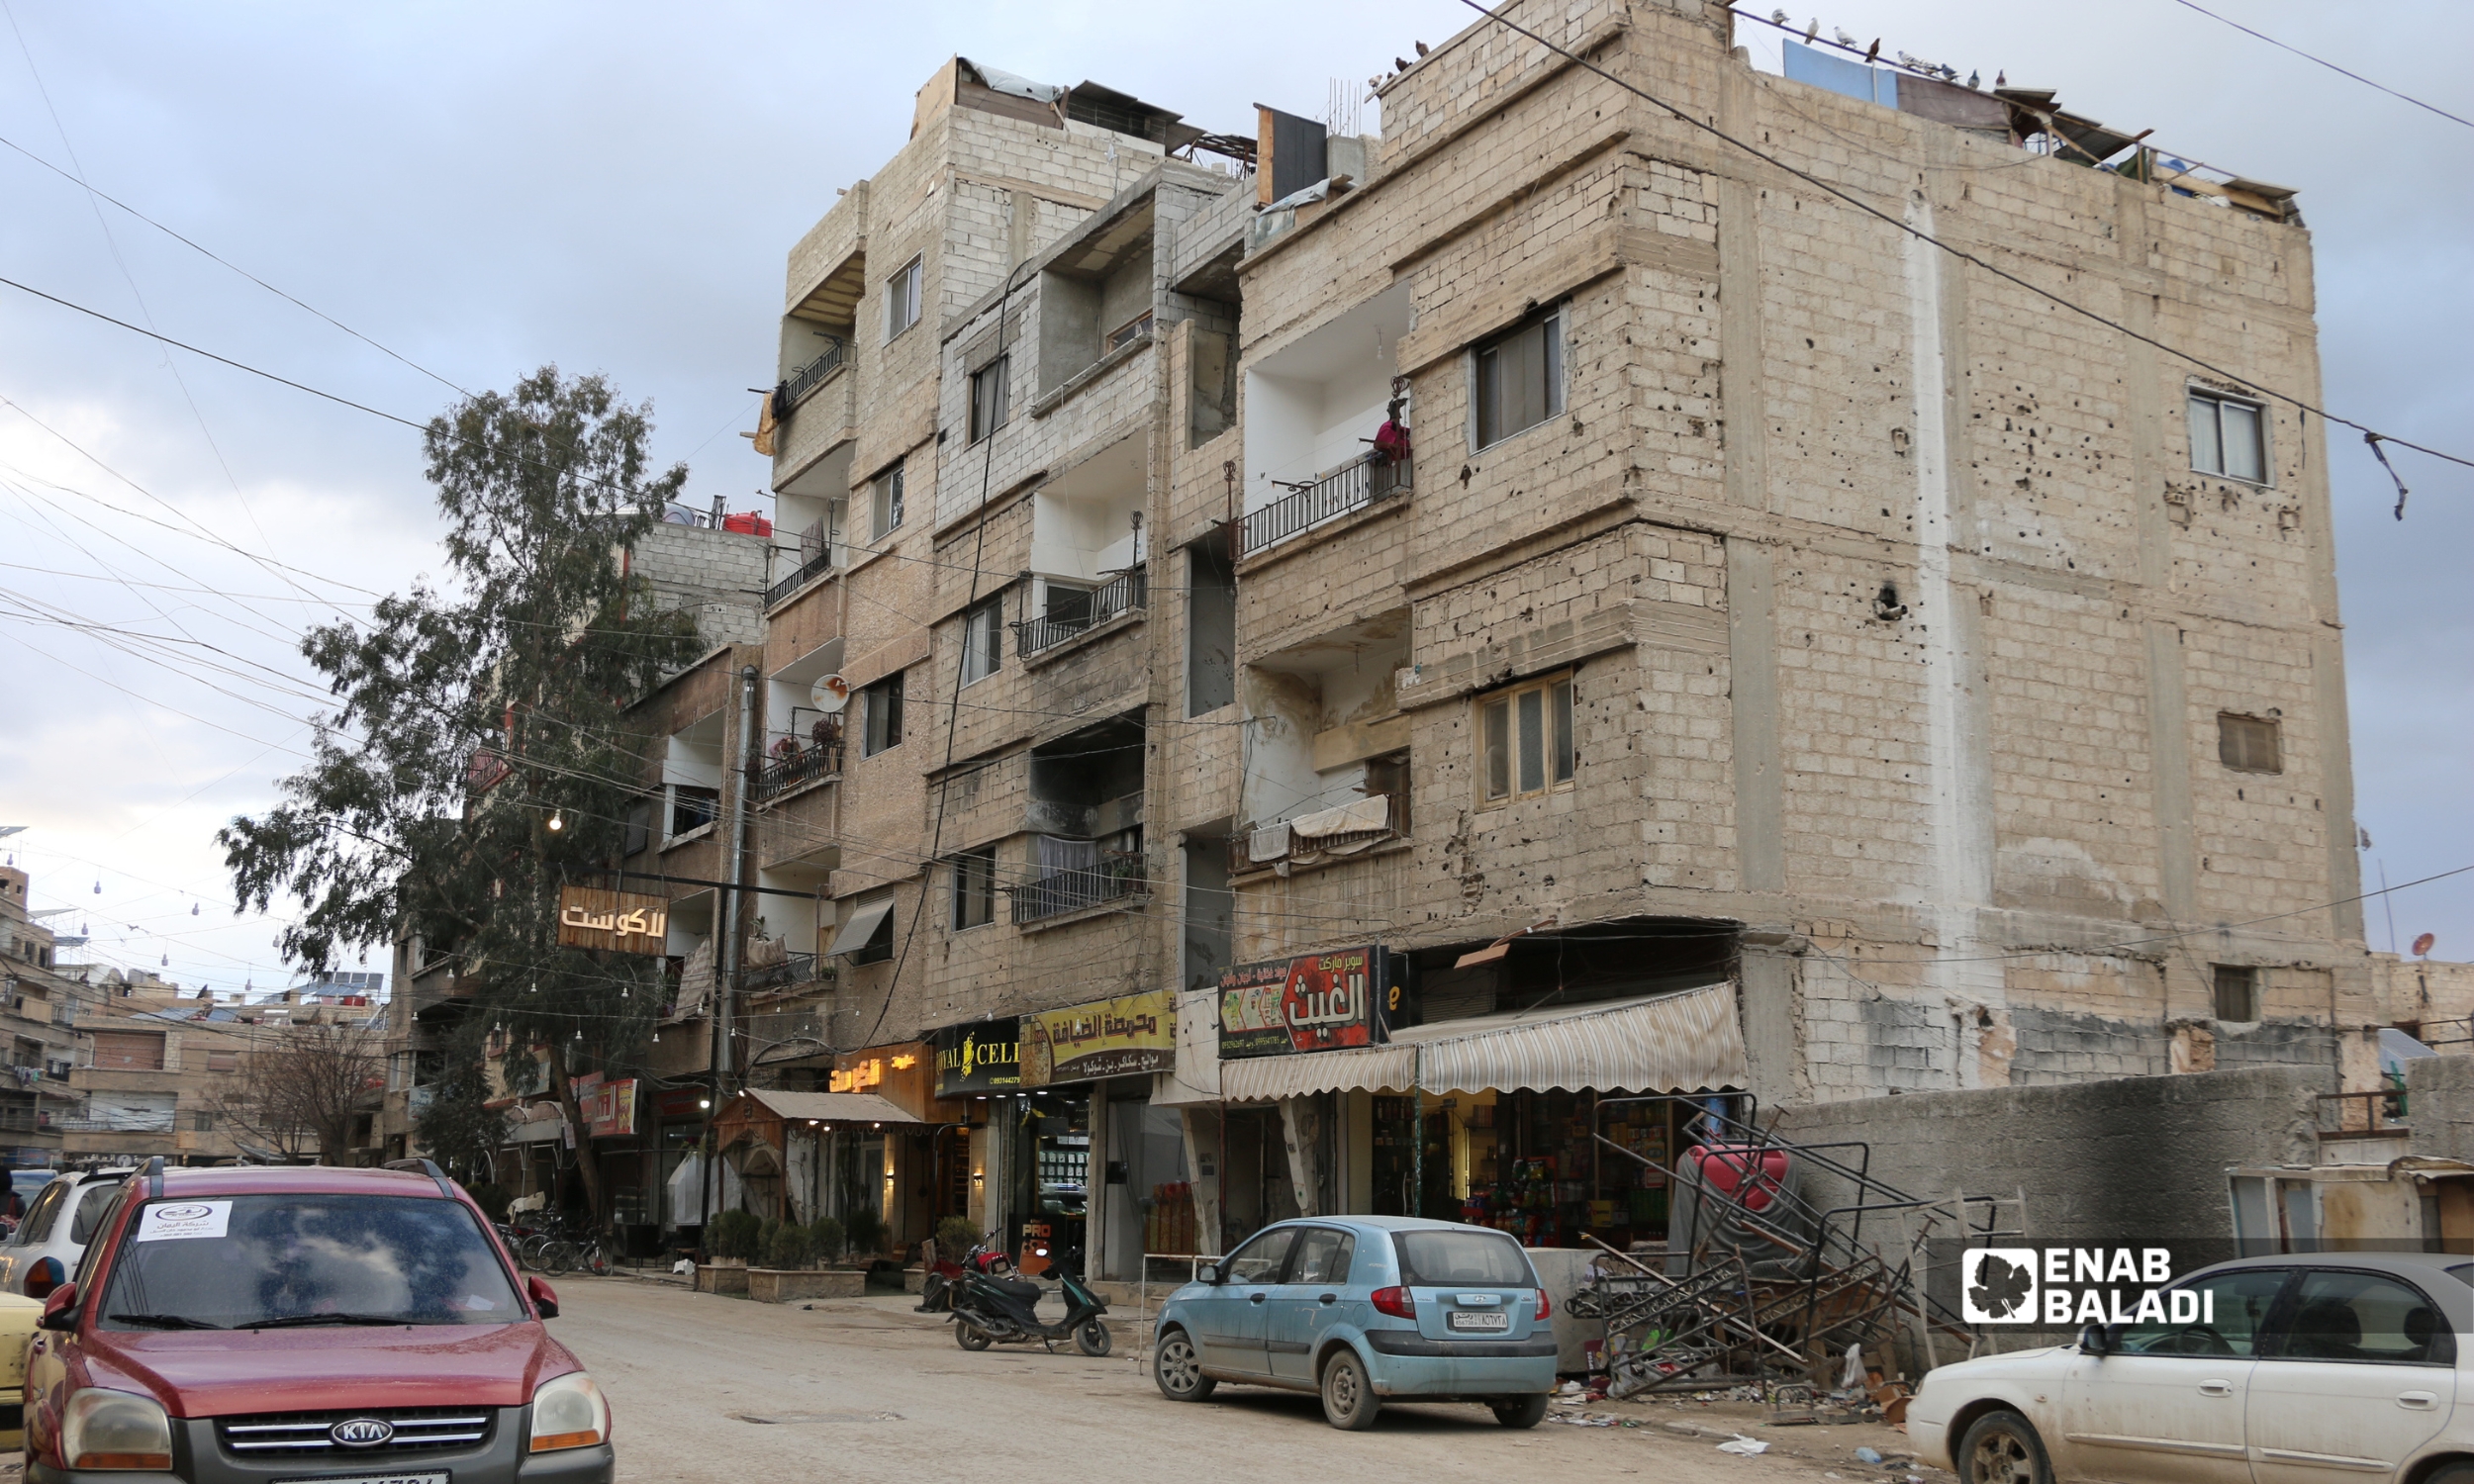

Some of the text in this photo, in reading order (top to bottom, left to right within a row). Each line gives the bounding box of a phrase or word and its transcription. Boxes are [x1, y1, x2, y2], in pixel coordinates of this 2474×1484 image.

[561, 905, 665, 938] لاكوست
[1318, 955, 1364, 974] سوبر ماركت
[1289, 974, 1365, 1038] الغيث
[1053, 1014, 1102, 1049] الضيافة
[1104, 1012, 1157, 1039] محمصة
[1022, 1224, 1051, 1238] PRO
[343, 1424, 383, 1439] KIA
